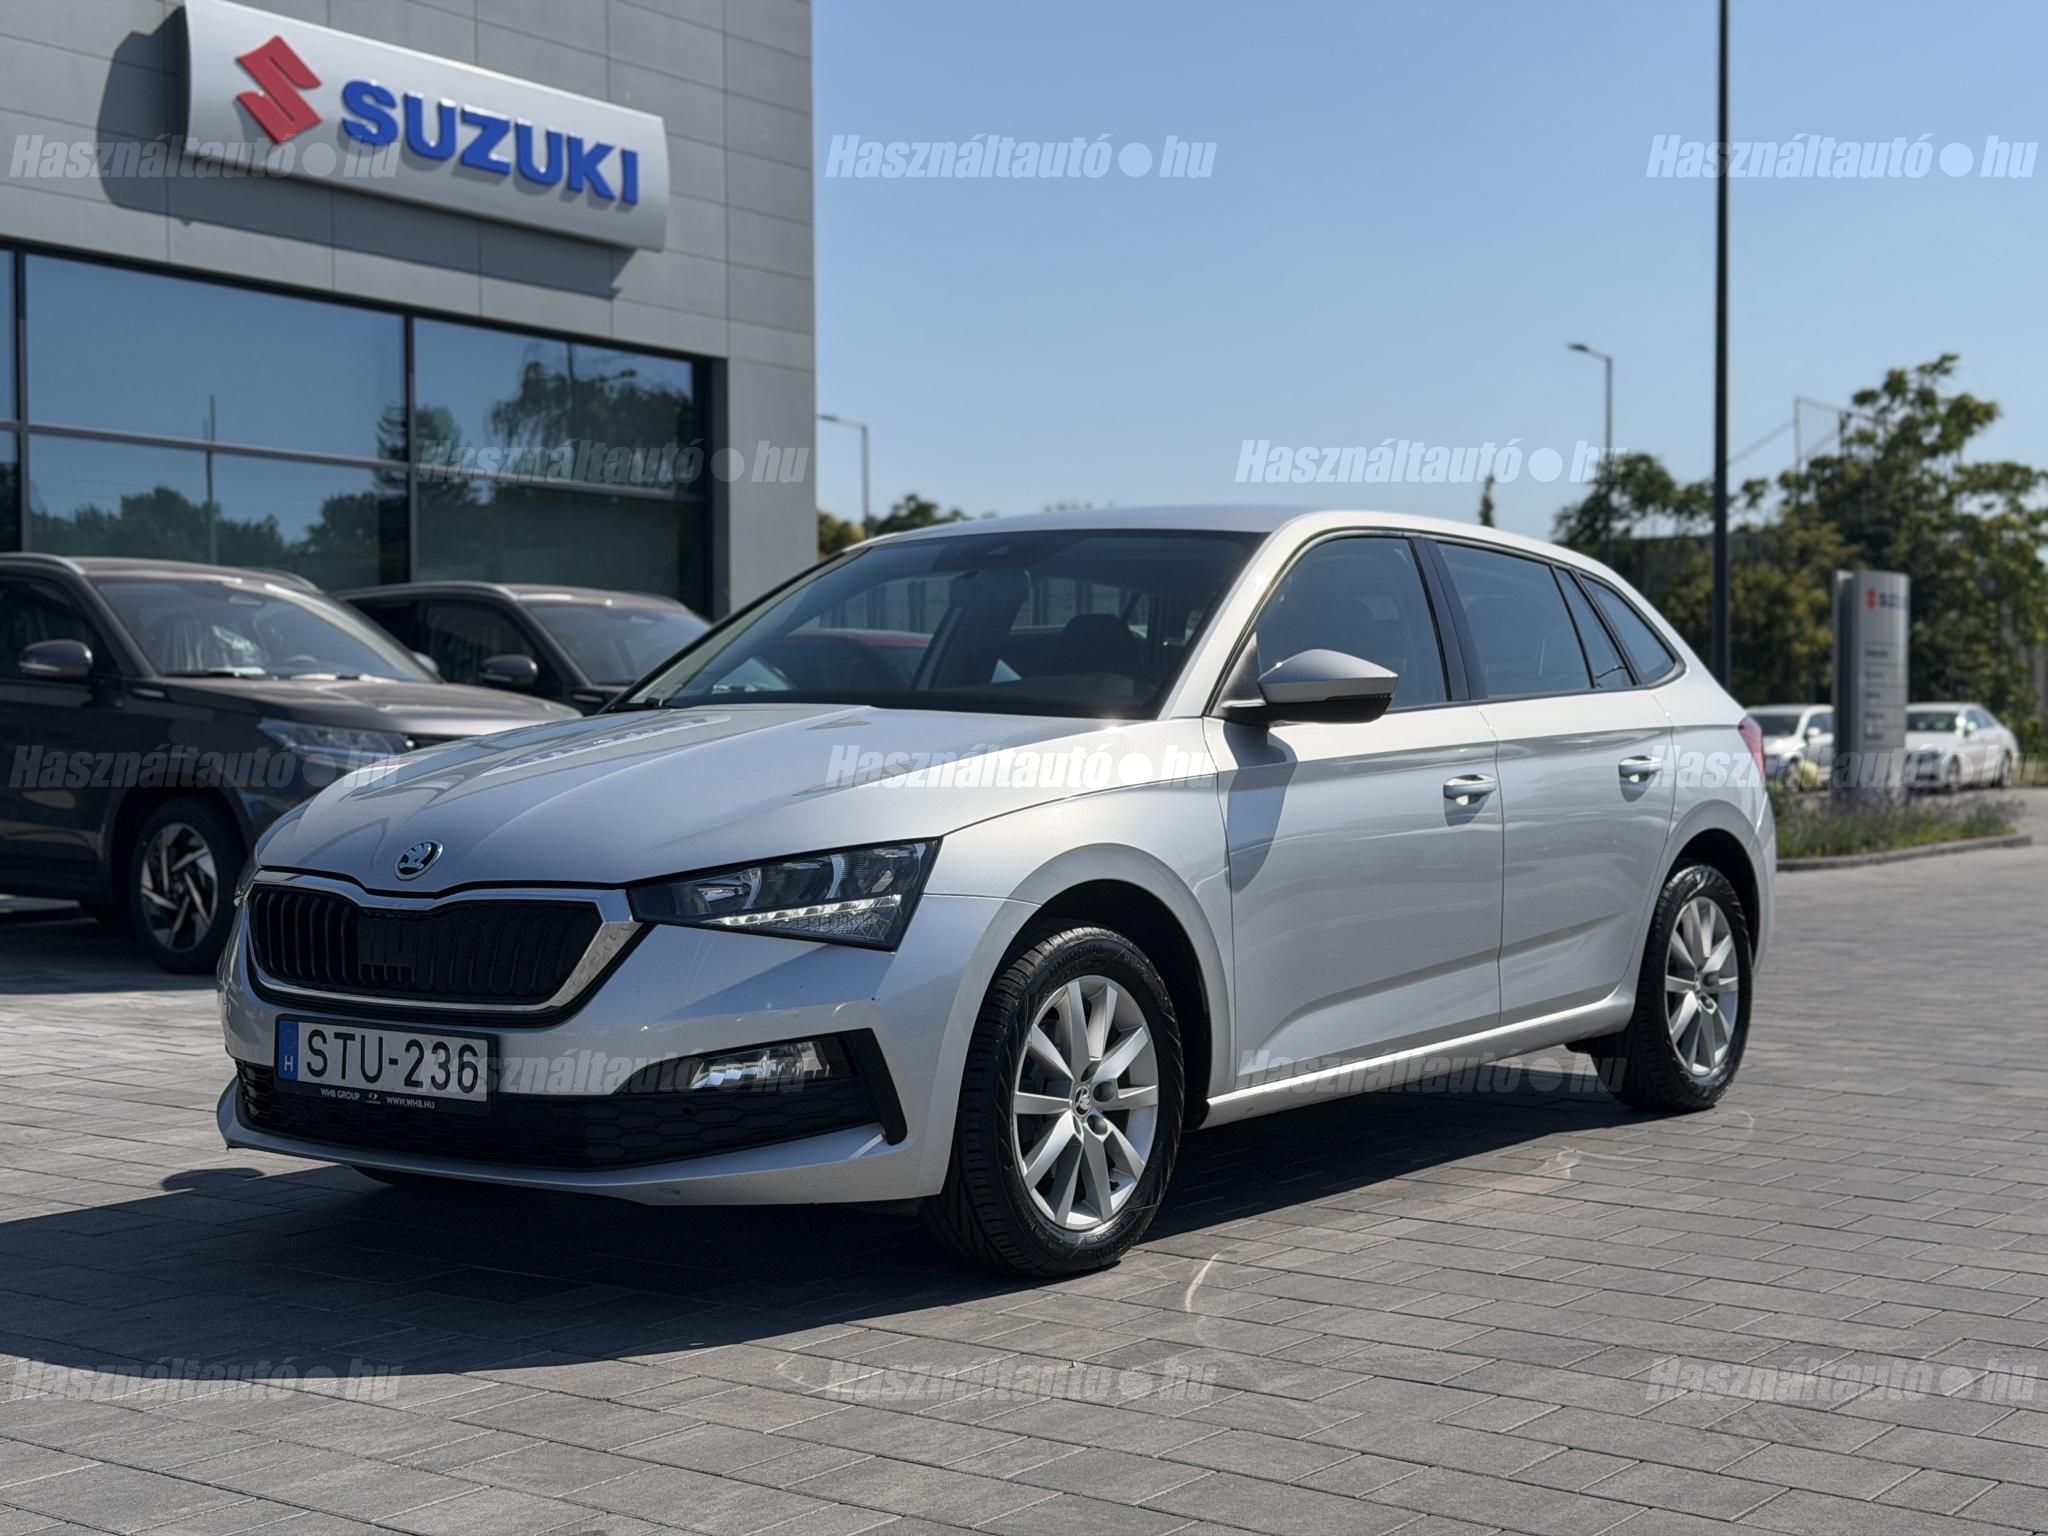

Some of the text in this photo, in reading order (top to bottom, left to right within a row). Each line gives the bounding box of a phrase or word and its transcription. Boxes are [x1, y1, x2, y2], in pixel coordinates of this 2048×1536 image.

[341, 79, 640, 206] SUZUKI
[284, 1028, 479, 1094] H STU-236
[320, 1087, 337, 1098] WHB
[337, 1089, 361, 1101] GROUP
[386, 1095, 435, 1110] WWW.WHB.HU
